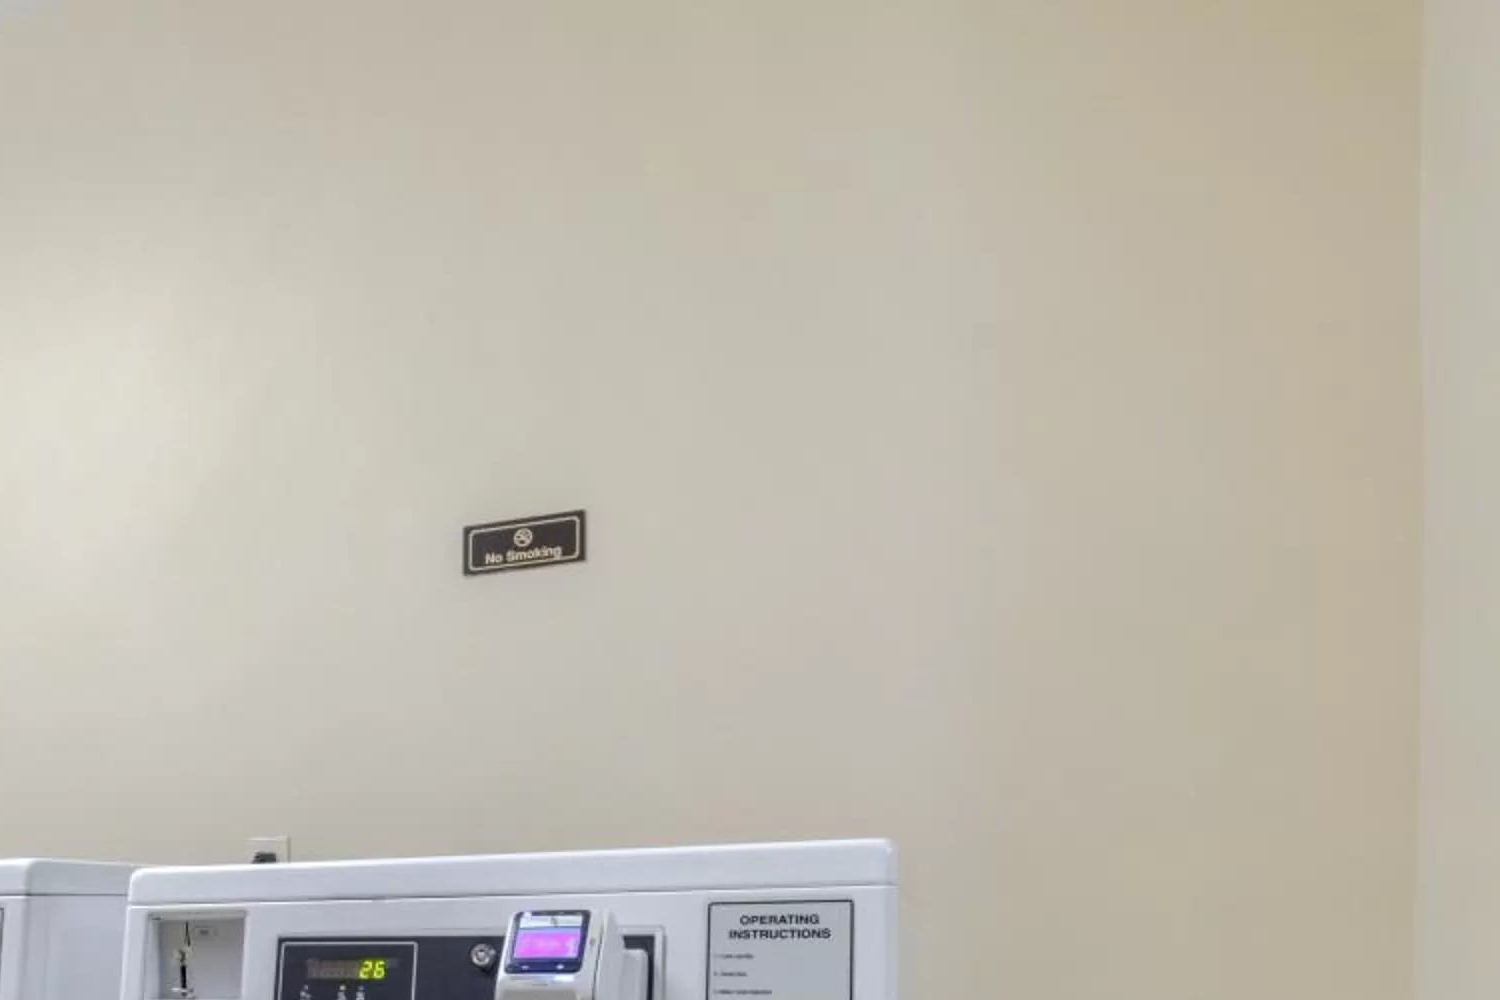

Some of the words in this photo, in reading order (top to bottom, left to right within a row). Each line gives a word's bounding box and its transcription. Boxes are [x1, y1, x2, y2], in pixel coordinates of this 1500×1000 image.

[485, 552, 504, 564] No
[506, 545, 563, 561] Smoking
[739, 914, 820, 926] OPERATING
[728, 928, 832, 939] INSTRUCTIONS
[359, 960, 386, 979] 26
